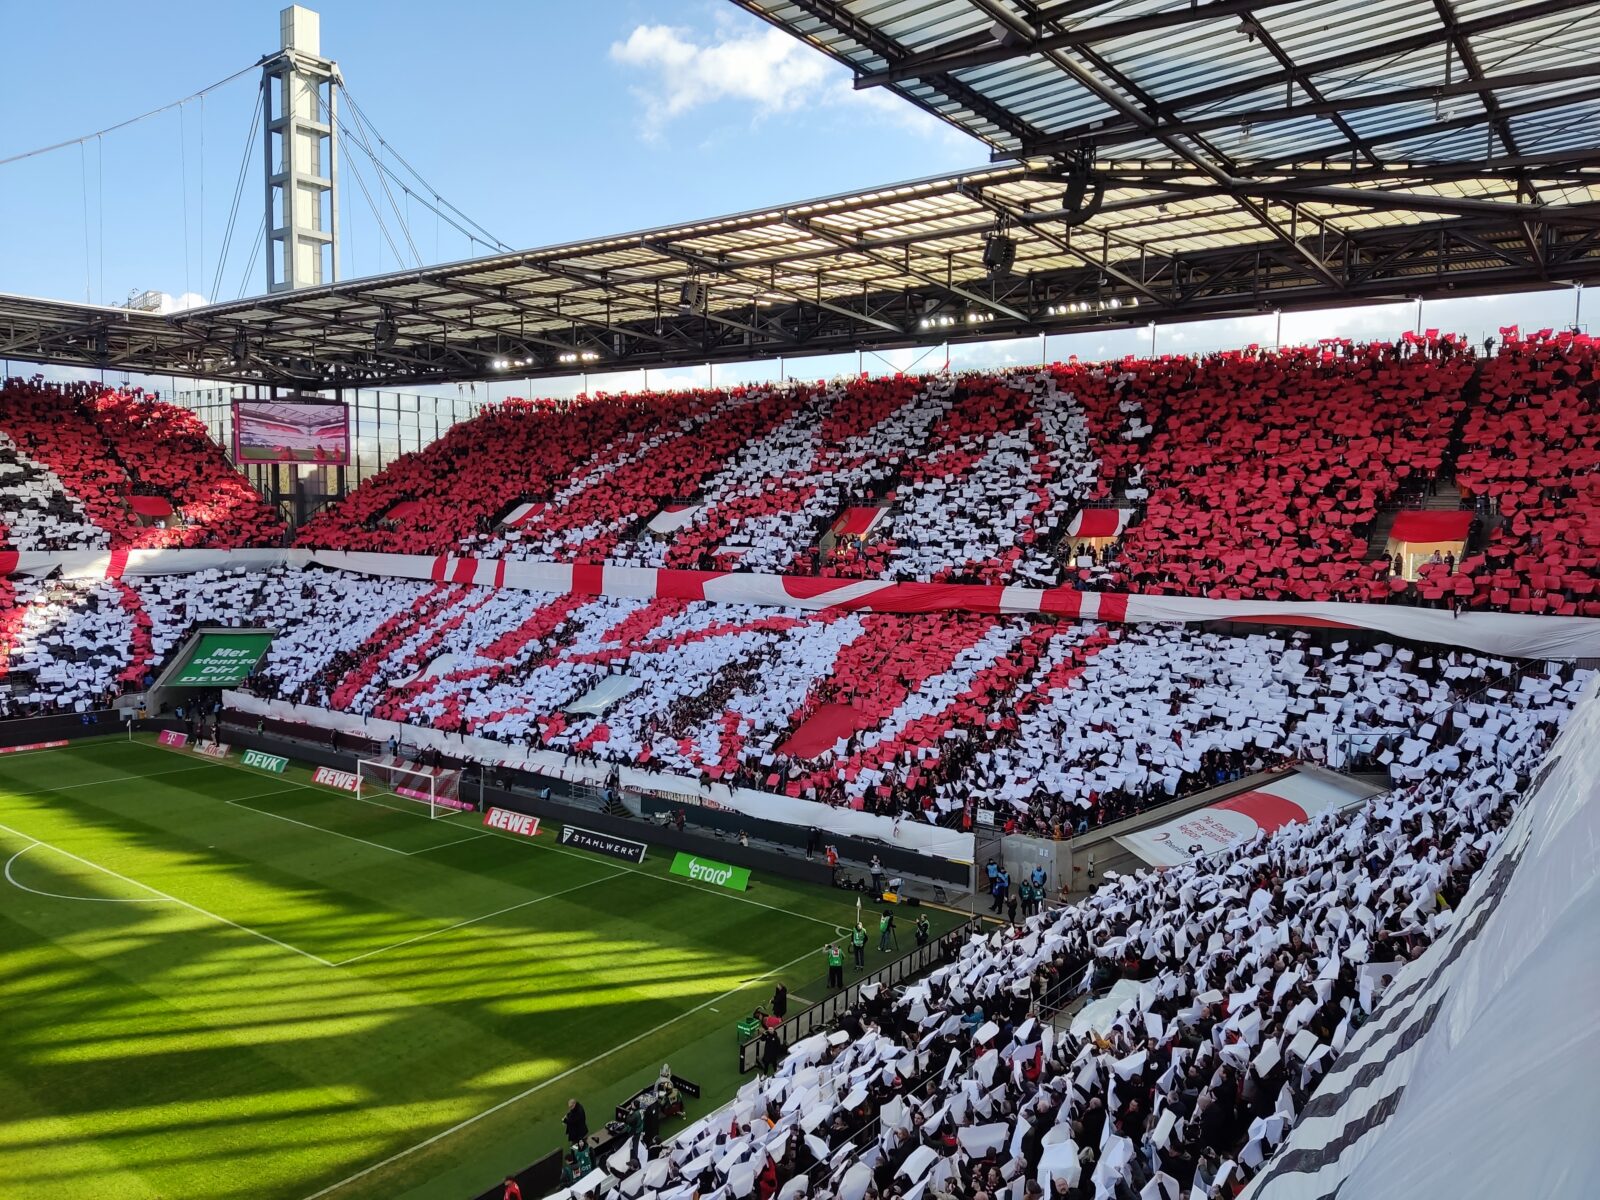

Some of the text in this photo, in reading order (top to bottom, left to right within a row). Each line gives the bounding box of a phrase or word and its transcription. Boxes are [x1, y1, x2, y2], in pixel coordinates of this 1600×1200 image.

[211, 648, 250, 657] Mer
[201, 666, 240, 674] Dir!
[244, 752, 281, 771] DEVK
[315, 769, 357, 791] REWE
[487, 808, 534, 835] REWE
[573, 834, 635, 856] STAHLWERK
